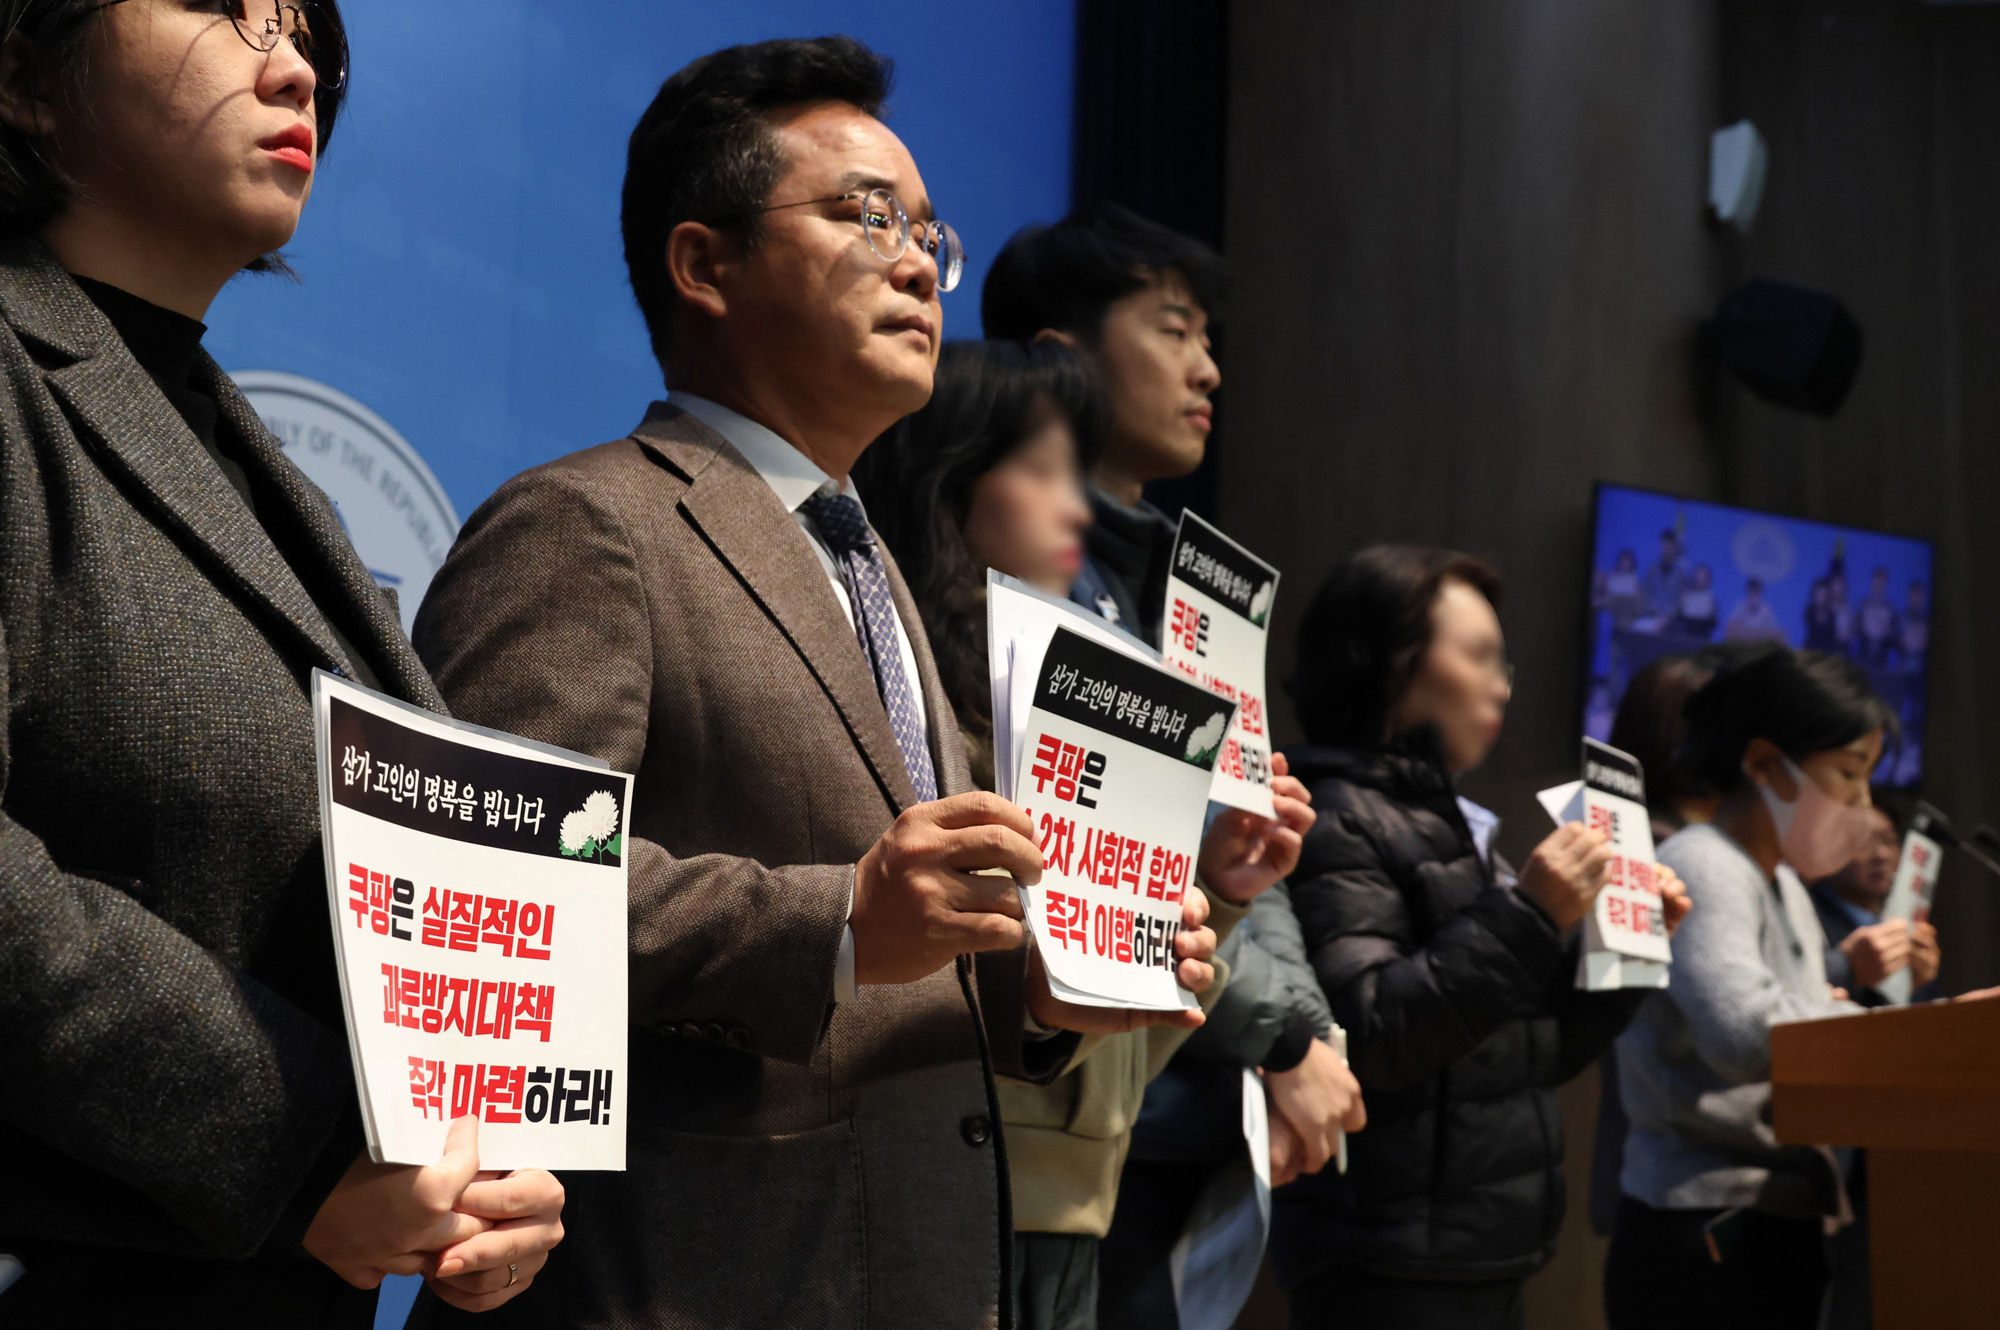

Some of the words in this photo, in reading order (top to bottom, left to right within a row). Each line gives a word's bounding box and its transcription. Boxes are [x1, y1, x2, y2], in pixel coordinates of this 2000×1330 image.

[1171, 597, 1209, 657] 쿠팡은
[1049, 664, 1079, 701] 삼가
[1075, 677, 1118, 716] 고인의
[1116, 690, 1151, 728] 명복을
[1150, 705, 1187, 742] 빕니다
[341, 745, 372, 793] 삼가
[373, 760, 419, 809] 고인의
[424, 775, 478, 822] 명복을
[483, 789, 545, 835] 빕니다
[1031, 733, 1107, 809] 쿠팡은
[1077, 827, 1146, 895] 사회적
[1146, 845, 1191, 906] 합의
[349, 862, 414, 941] 쿠팡은
[422, 886, 555, 960] 실질적인
[1046, 889, 1088, 955] 즉각
[381, 962, 555, 1042] 과로방지대책
[408, 1055, 446, 1121] 즉각
[450, 1063, 613, 1125] 마련하라!
